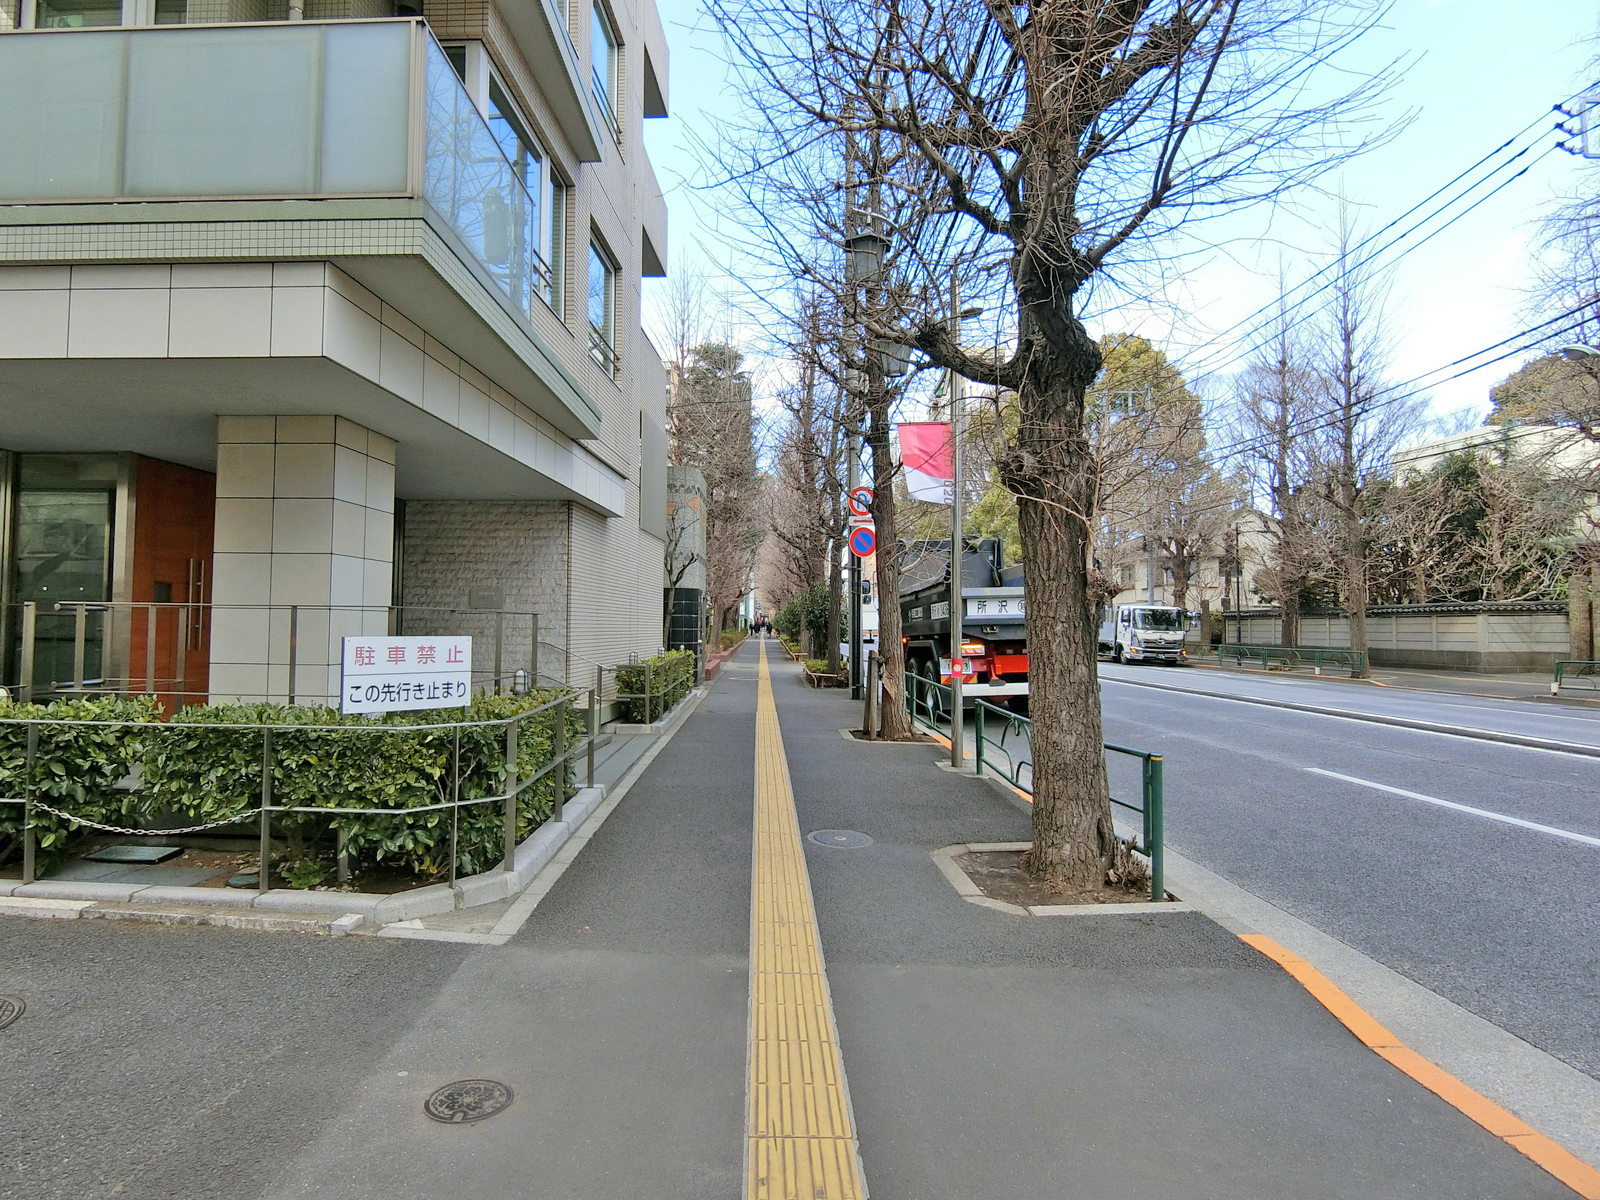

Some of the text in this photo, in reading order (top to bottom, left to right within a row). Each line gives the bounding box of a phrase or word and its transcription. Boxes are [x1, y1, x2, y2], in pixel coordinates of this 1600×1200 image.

[354, 645, 464, 666] 駐車禁止
[349, 681, 467, 703] この先行き止まり
